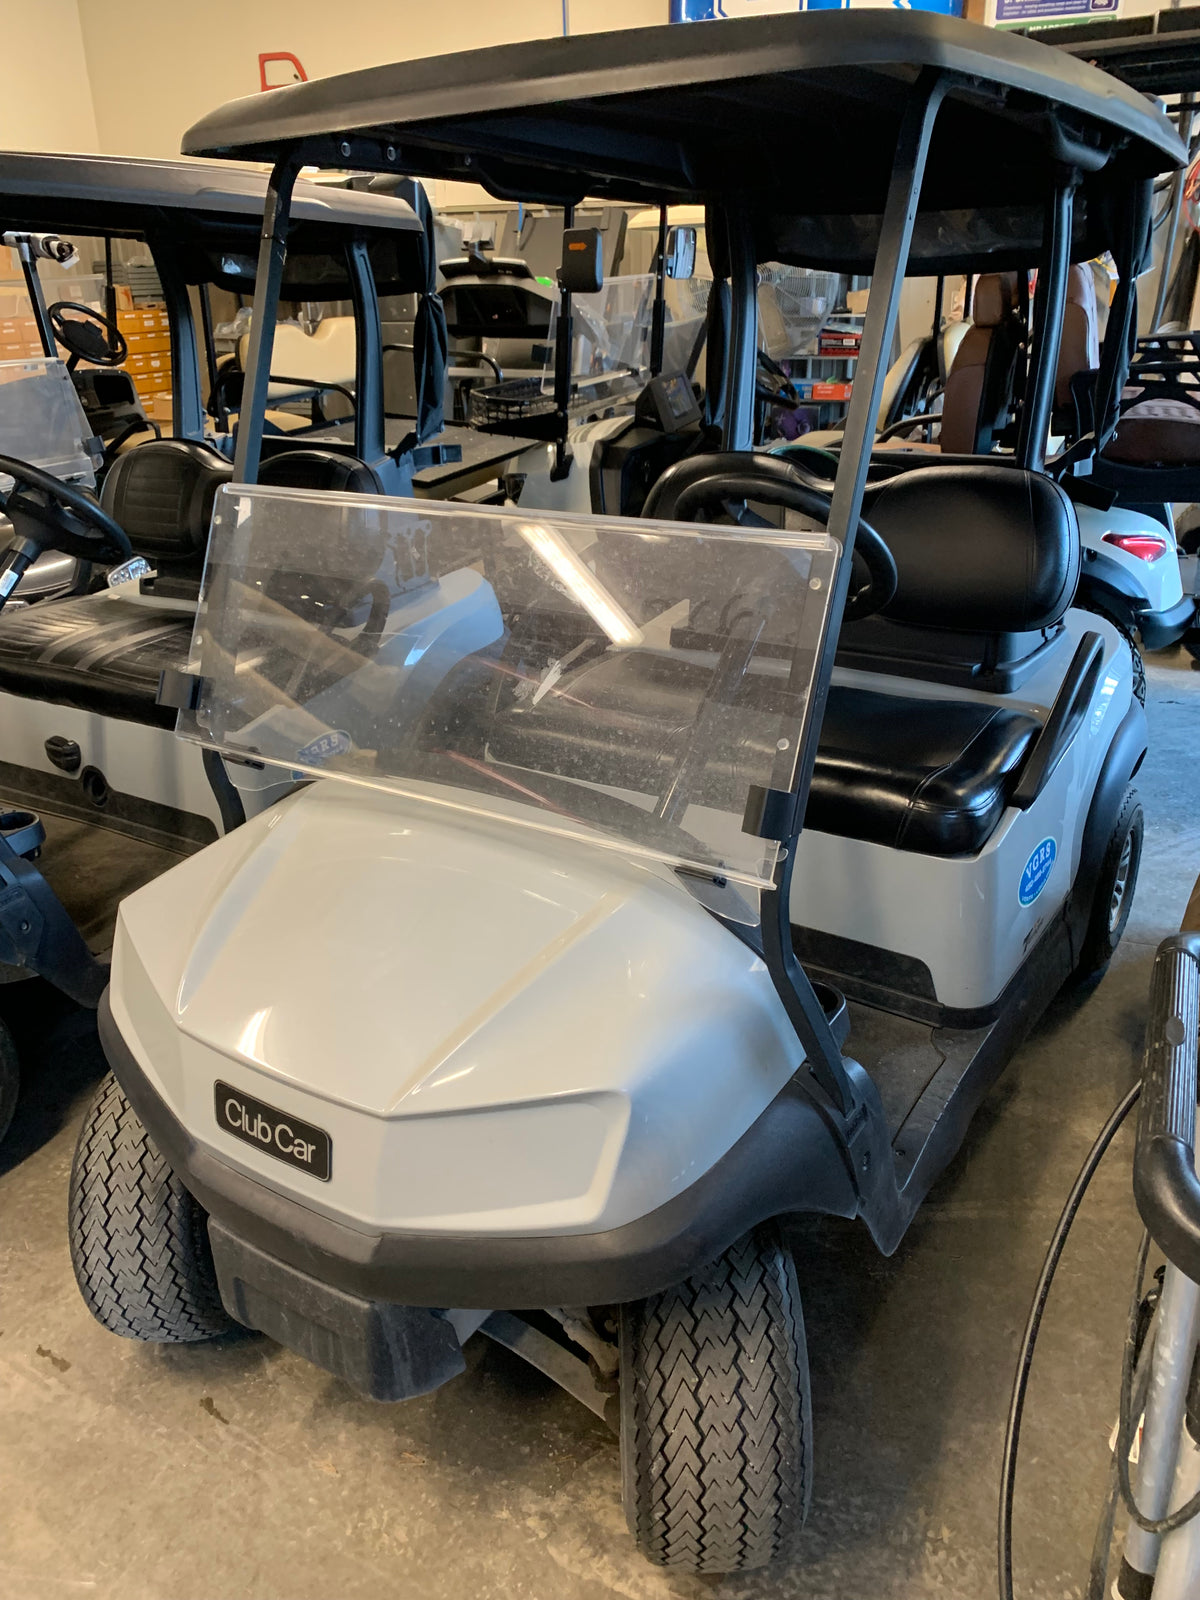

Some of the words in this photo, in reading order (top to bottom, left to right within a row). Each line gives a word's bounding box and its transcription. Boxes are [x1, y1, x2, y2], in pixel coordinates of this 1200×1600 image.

[1026, 841, 1051, 879] VGRS
[225, 1098, 272, 1144] Club
[274, 1123, 317, 1164] Car
